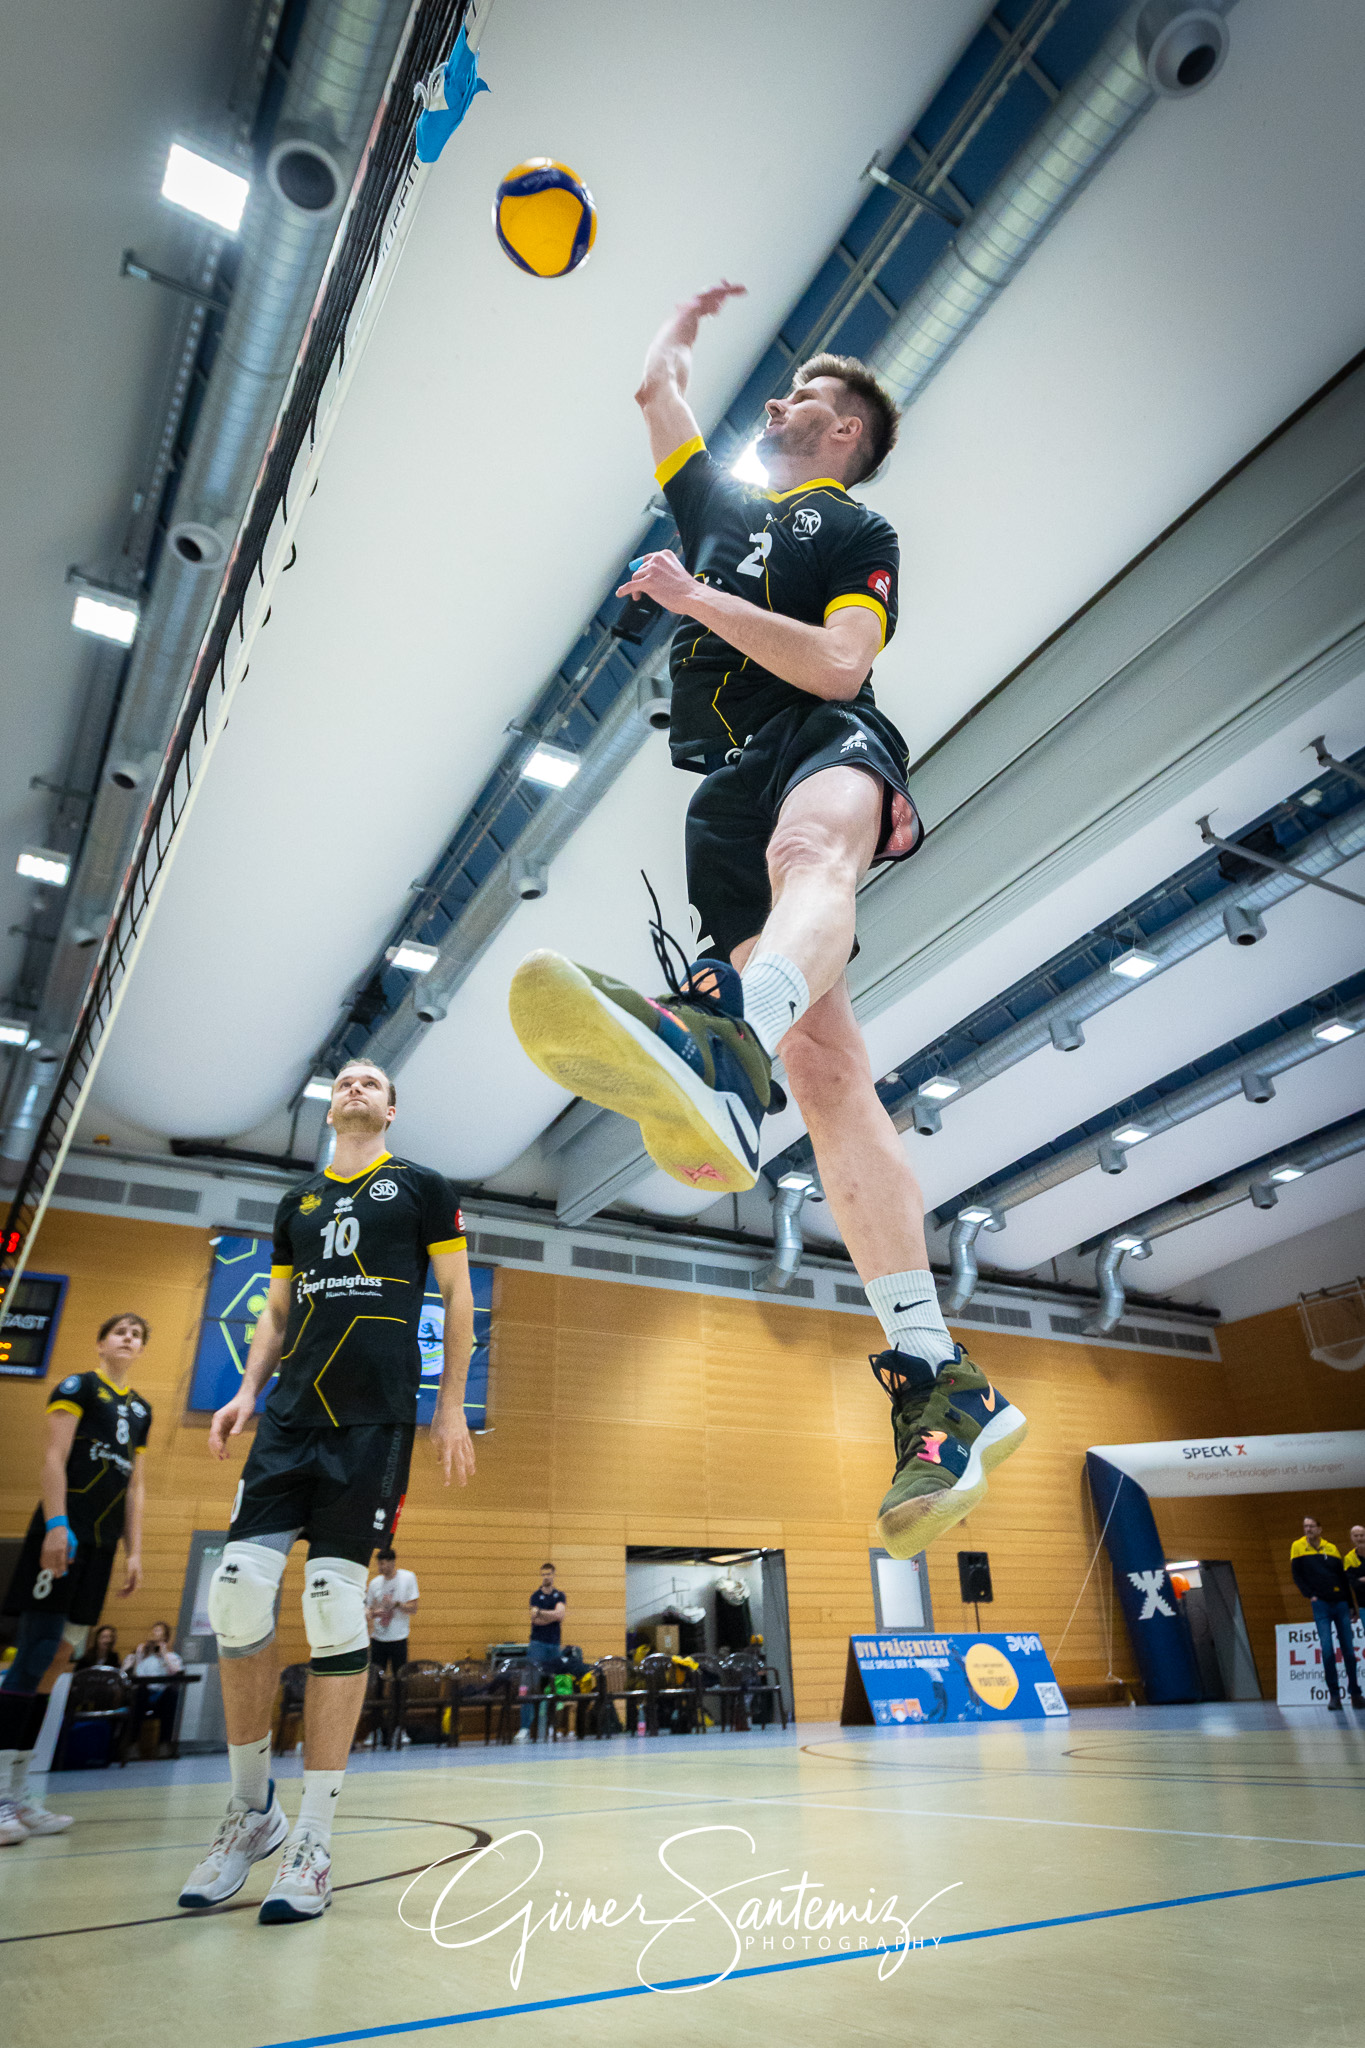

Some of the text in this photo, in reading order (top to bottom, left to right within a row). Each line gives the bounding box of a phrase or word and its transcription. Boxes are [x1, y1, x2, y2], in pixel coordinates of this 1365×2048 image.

[736, 532, 772, 578] 2
[320, 1217, 360, 1259] 10
[327, 1275, 382, 1288] Daigfuss
[116, 1418, 130, 1445] 8
[1182, 1445, 1232, 1460] SPECK
[1282, 1465, 1298, 1474] und
[32, 1568, 54, 1600] 8
[854, 1638, 951, 1658] DYN PRÄSENTIERT
